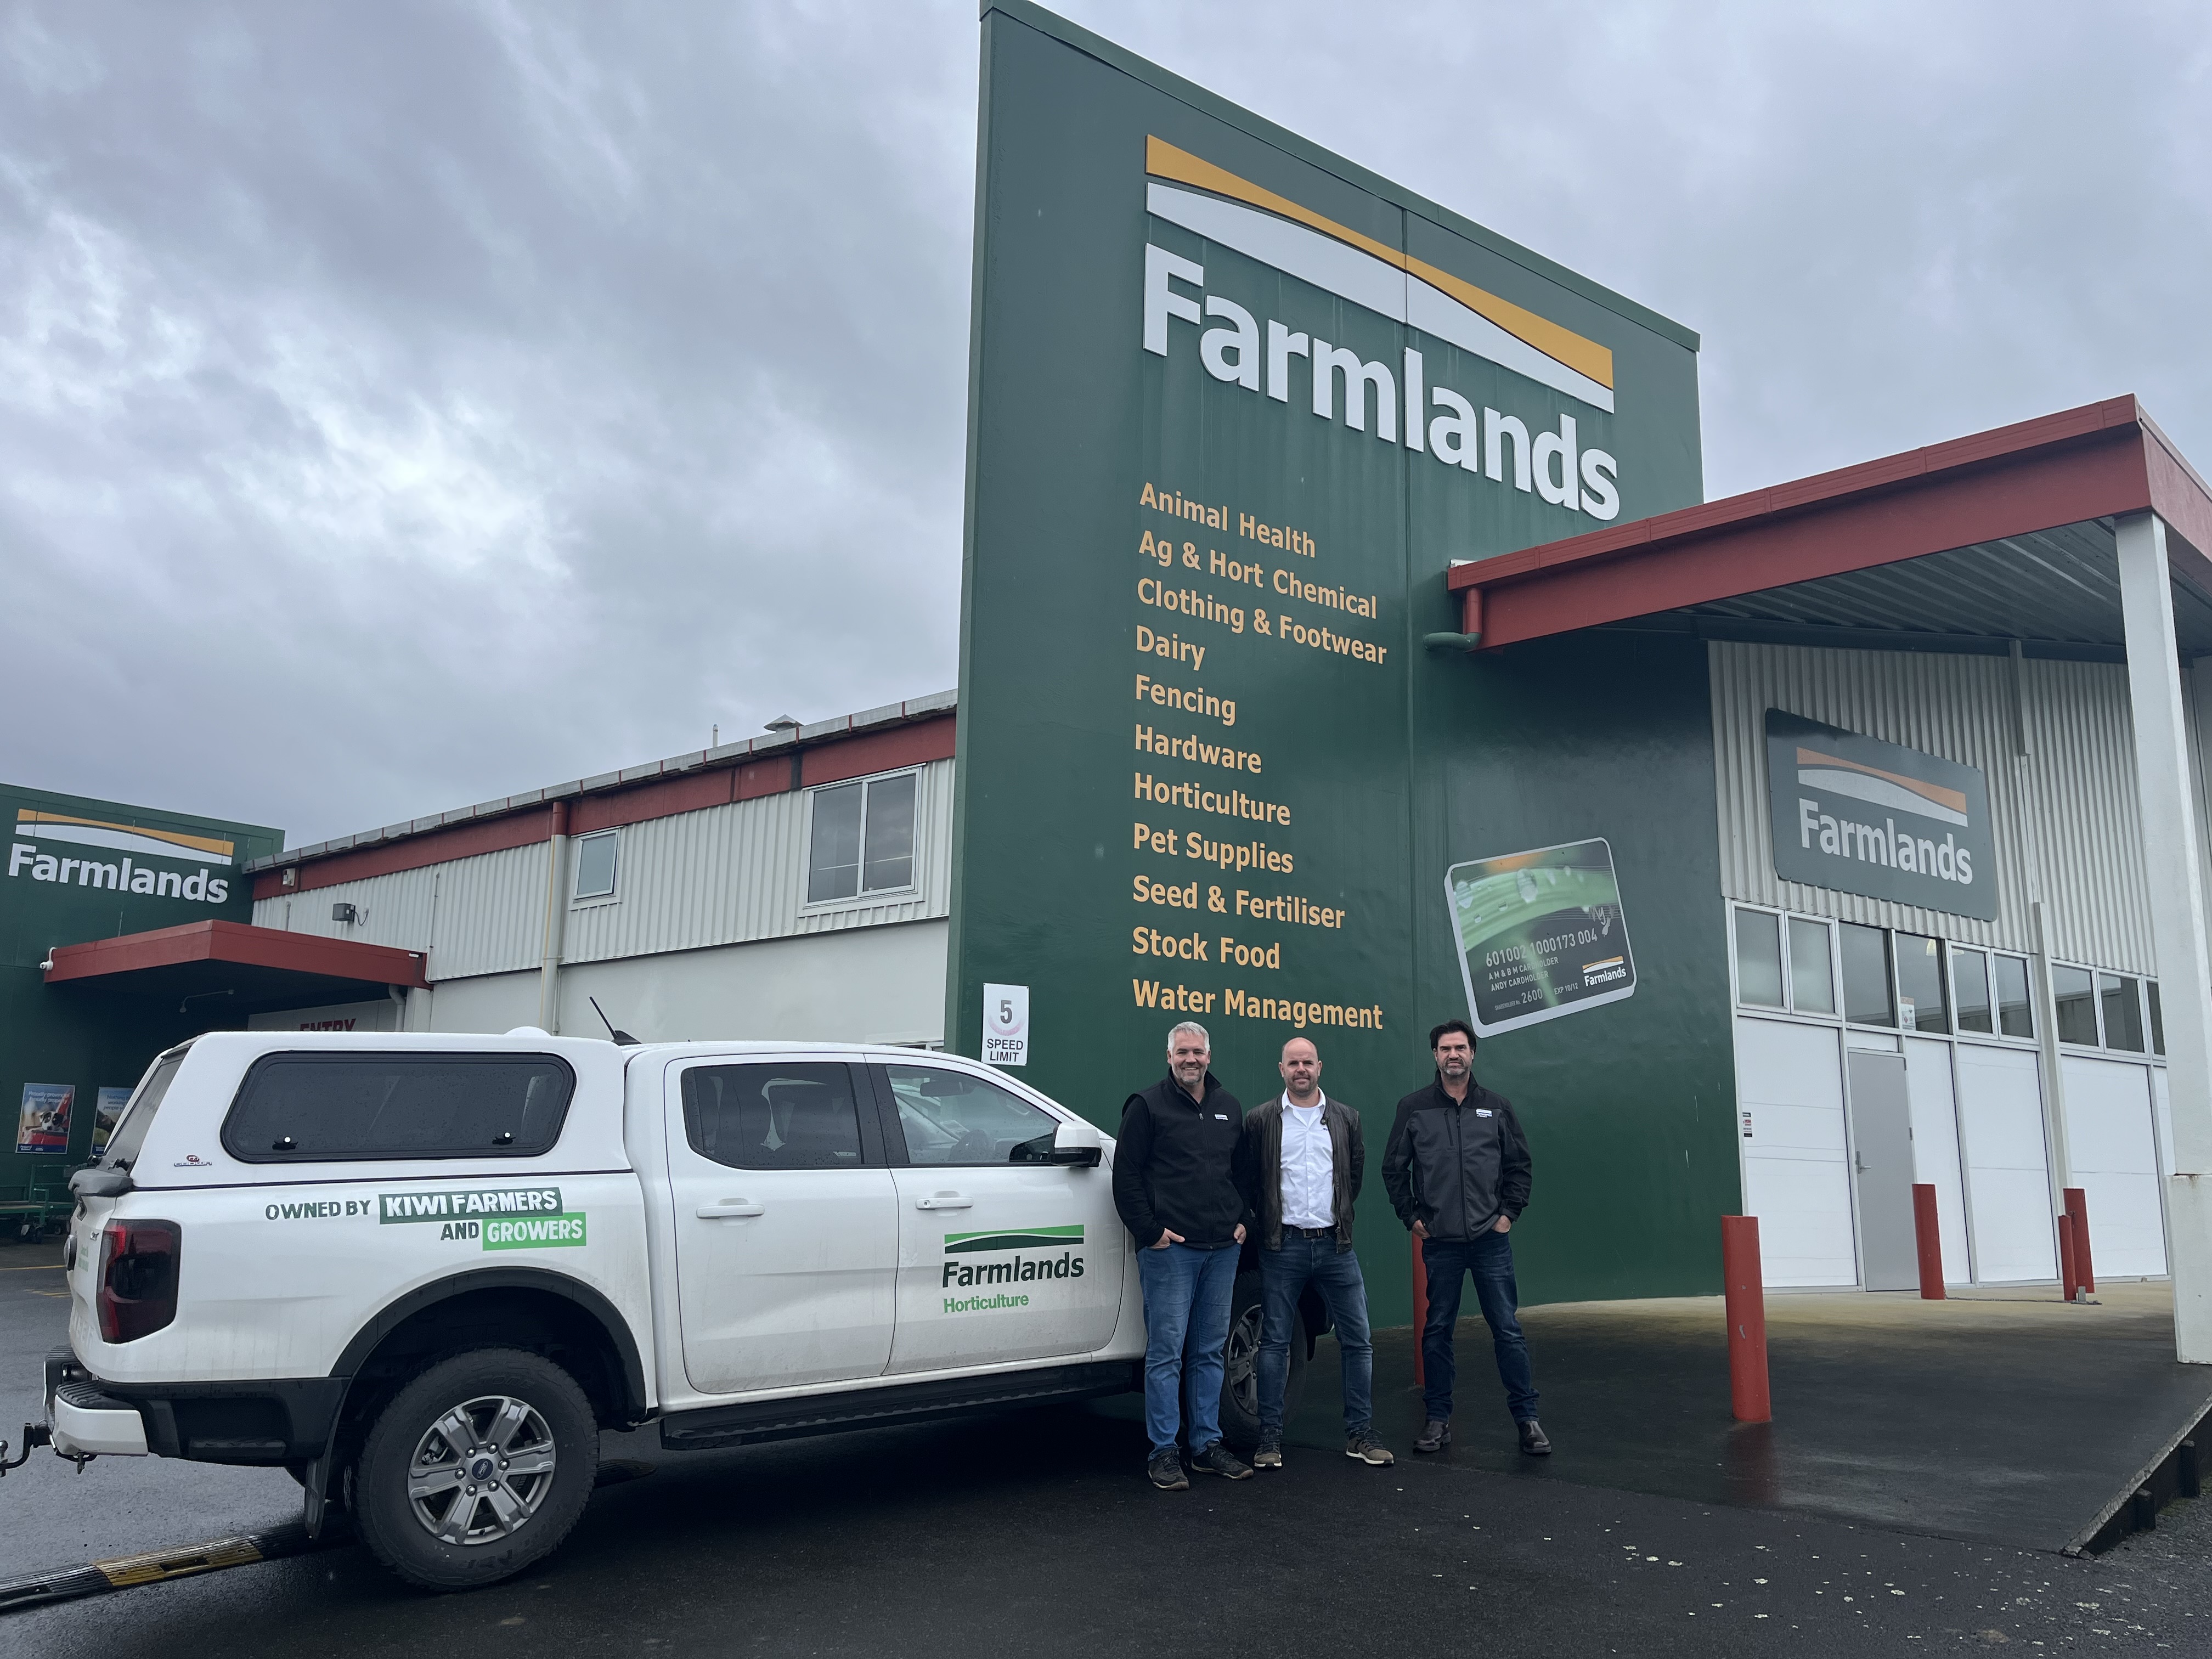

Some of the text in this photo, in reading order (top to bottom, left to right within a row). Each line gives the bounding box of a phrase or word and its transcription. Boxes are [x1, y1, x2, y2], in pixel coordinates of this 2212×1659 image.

[1143, 242, 1620, 521] Farmlands
[1139, 482, 1316, 558] Animal Health
[1138, 530, 1376, 619] Ag & Hort Chemical
[1137, 578, 1387, 664] Clothing & Footwear
[1136, 624, 1205, 671] Dairy
[1136, 674, 1235, 726] Fencing
[1135, 724, 1261, 773] Hardware
[1135, 772, 1290, 826] Horticulture
[1133, 822, 1294, 873] Pet Supplies
[1799, 798, 1973, 885] Farmlands
[8, 843, 229, 904] Farmlands
[1133, 875, 1345, 929] Seed & Fertiliser
[1132, 927, 1280, 969] Stock Food
[1486, 928, 1598, 967] 601002 1000173 004
[1489, 972, 1493, 980] A
[1494, 970, 1500, 979] M
[1506, 968, 1511, 976] B
[1512, 966, 1519, 974] M
[1519, 956, 1559, 973] CARDHOLDER
[1491, 970, 1549, 992] ANDY CARDHOLDER
[1521, 988, 1543, 1003] 2600
[1554, 986, 1564, 995] EXP
[1565, 982, 1579, 992] 10/12
[1584, 967, 1627, 987] Farmlands
[1000, 1000, 1013, 1024] 5
[1132, 979, 1383, 1030] Water Management
[987, 1039, 1024, 1051] SPEED
[990, 1051, 1019, 1062] LIMIT
[266, 1190, 557, 1220] OWNED BY KIWI FARMERS
[440, 1220, 583, 1243] AND GROWERS
[943, 1252, 1084, 1288] Farmlands
[944, 1294, 1029, 1313] Horticulture
